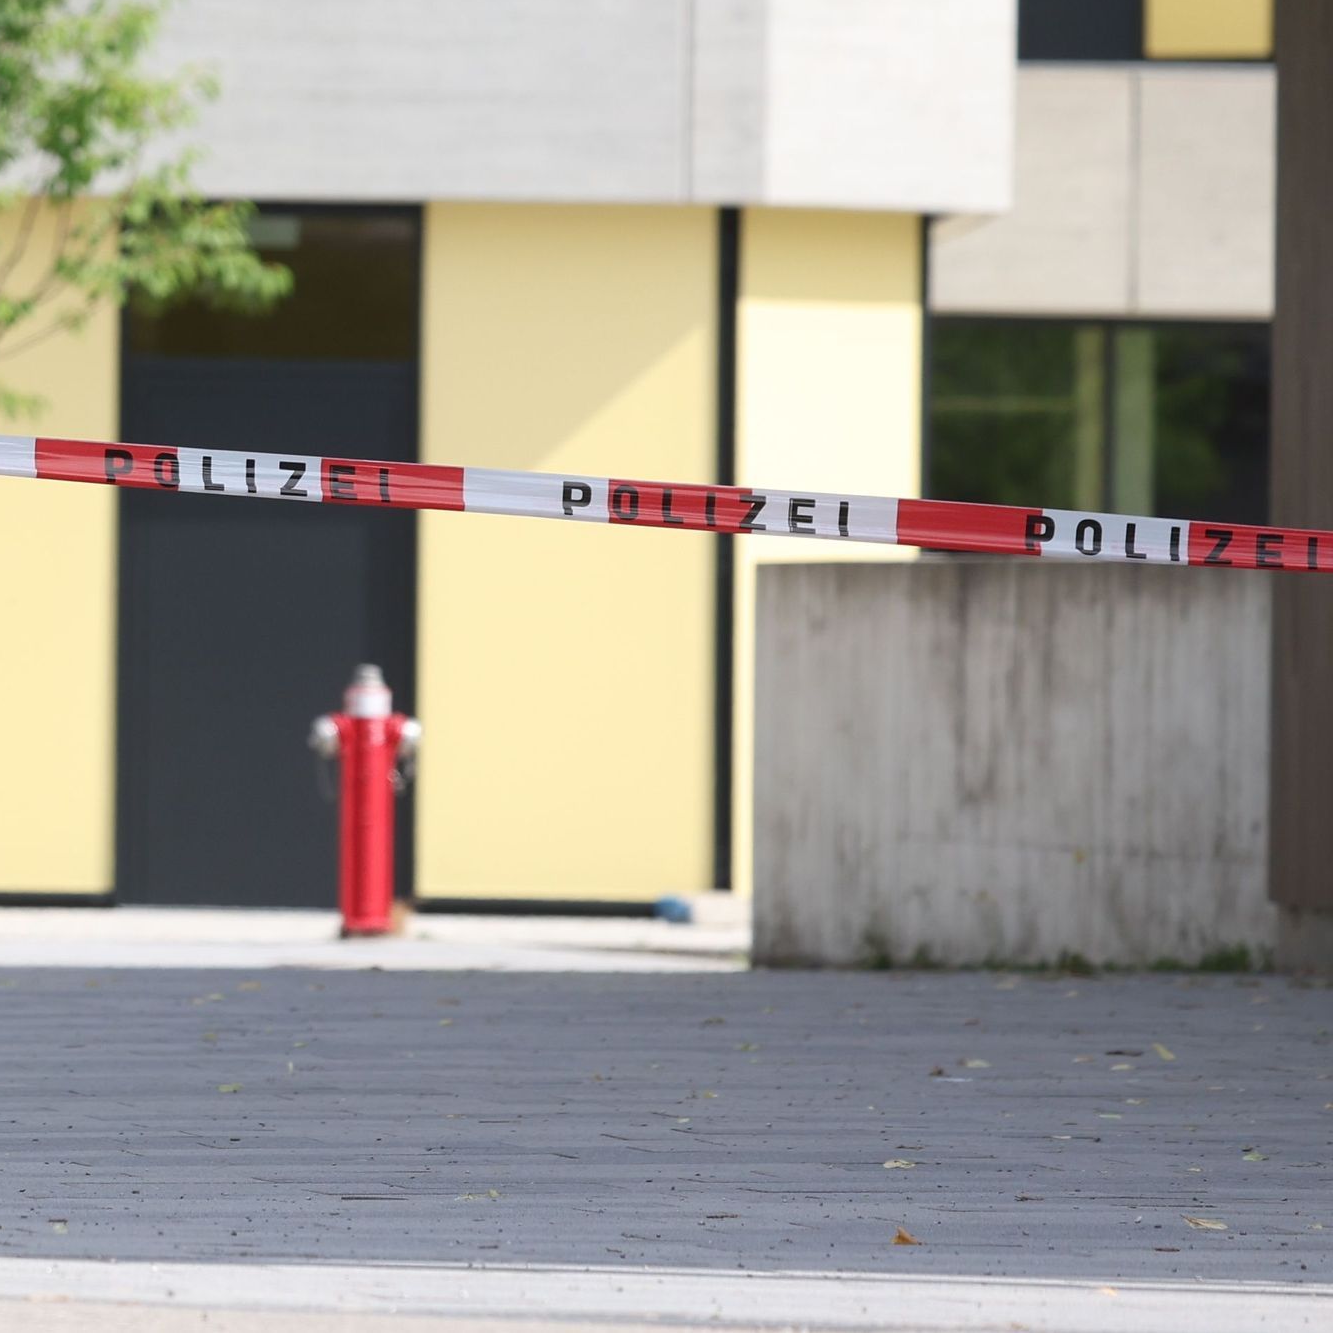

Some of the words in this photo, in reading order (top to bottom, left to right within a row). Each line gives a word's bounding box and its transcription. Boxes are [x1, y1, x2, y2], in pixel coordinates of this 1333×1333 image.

[103, 448, 392, 503] POLIZEI
[562, 480, 850, 538] POLIZEI
[1025, 513, 1319, 571] POLIZEI
